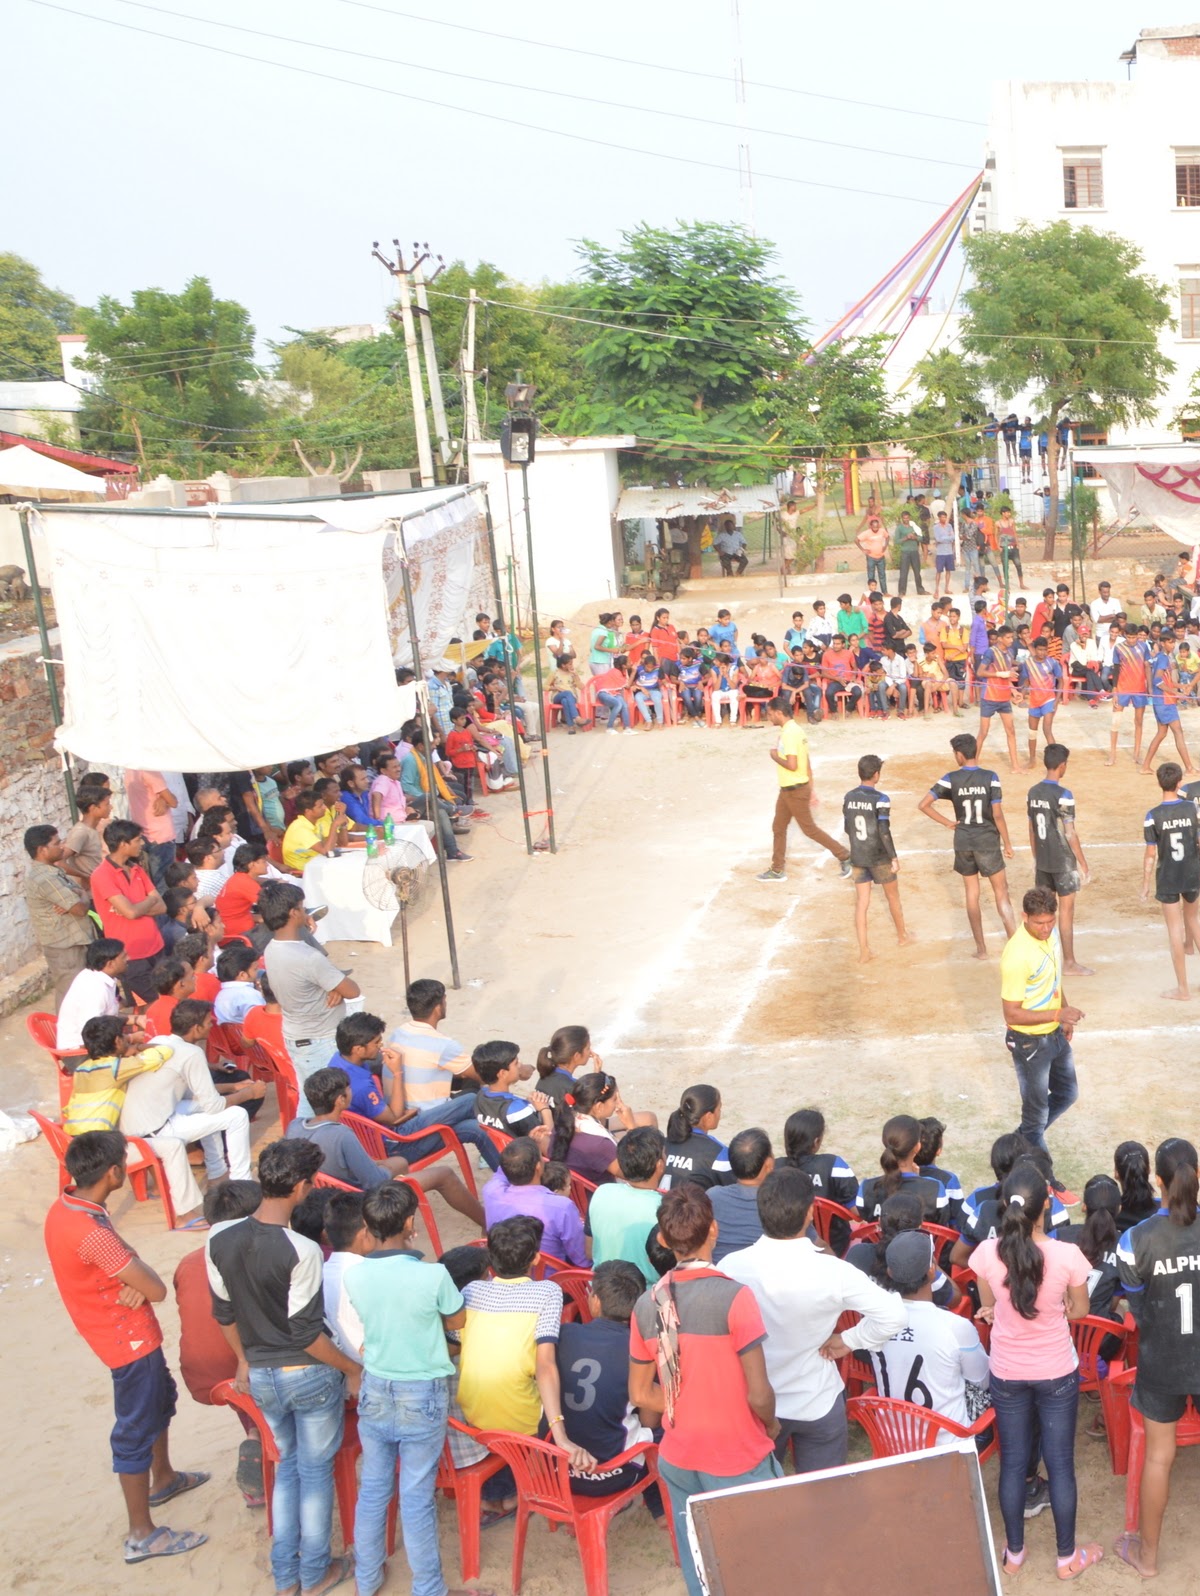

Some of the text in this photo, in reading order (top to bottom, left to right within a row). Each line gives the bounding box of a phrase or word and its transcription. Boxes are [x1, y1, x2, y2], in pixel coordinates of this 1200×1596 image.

[958, 786, 986, 796] ALPHA
[847, 801, 873, 811] ALPHA
[962, 799, 984, 825] 11
[1030, 800, 1050, 810] ALPHA
[854, 815, 868, 841] 9
[1036, 812, 1047, 840] 8
[1162, 817, 1192, 831] ALPHA
[1170, 832, 1185, 862] 5
[1175, 1282, 1194, 1335] 1
[564, 1357, 602, 1412] 3
